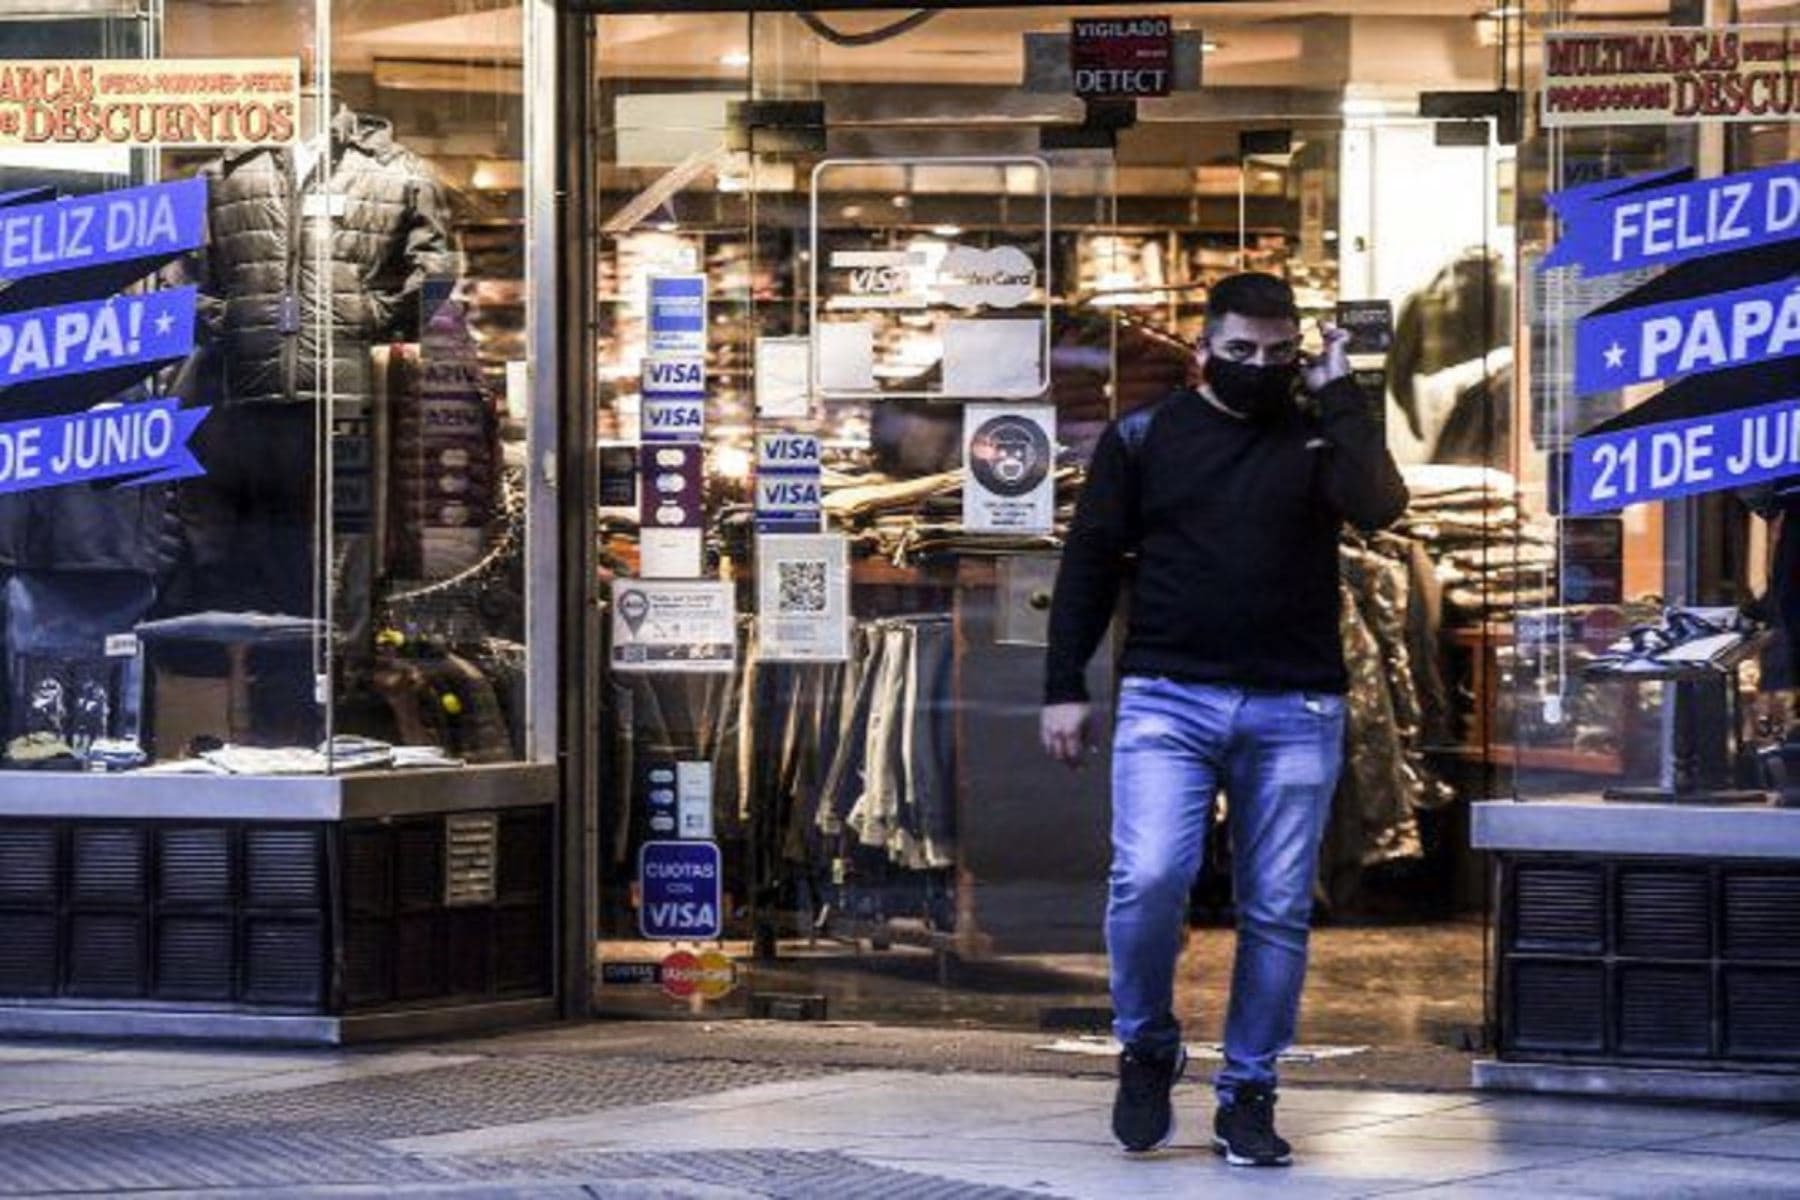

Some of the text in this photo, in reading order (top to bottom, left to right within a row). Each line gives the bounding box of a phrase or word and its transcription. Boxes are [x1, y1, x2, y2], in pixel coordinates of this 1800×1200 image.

[1078, 22, 1168, 37] VIGILADO
[1076, 69, 1166, 92] DETECT
[23, 101, 294, 143] DESCUENTOS
[0, 194, 178, 270] ELIZ DIA
[1611, 182, 1753, 263] FELIZ
[650, 363, 700, 383] VISA
[649, 408, 701, 426] VISA
[52, 408, 172, 475] JUNIO
[764, 439, 817, 459] VISA
[1591, 439, 1637, 500] 21
[1651, 424, 1714, 490] DE
[764, 484, 817, 504] VISA
[646, 864, 714, 878] CUOTAS
[650, 903, 715, 928] VISA
